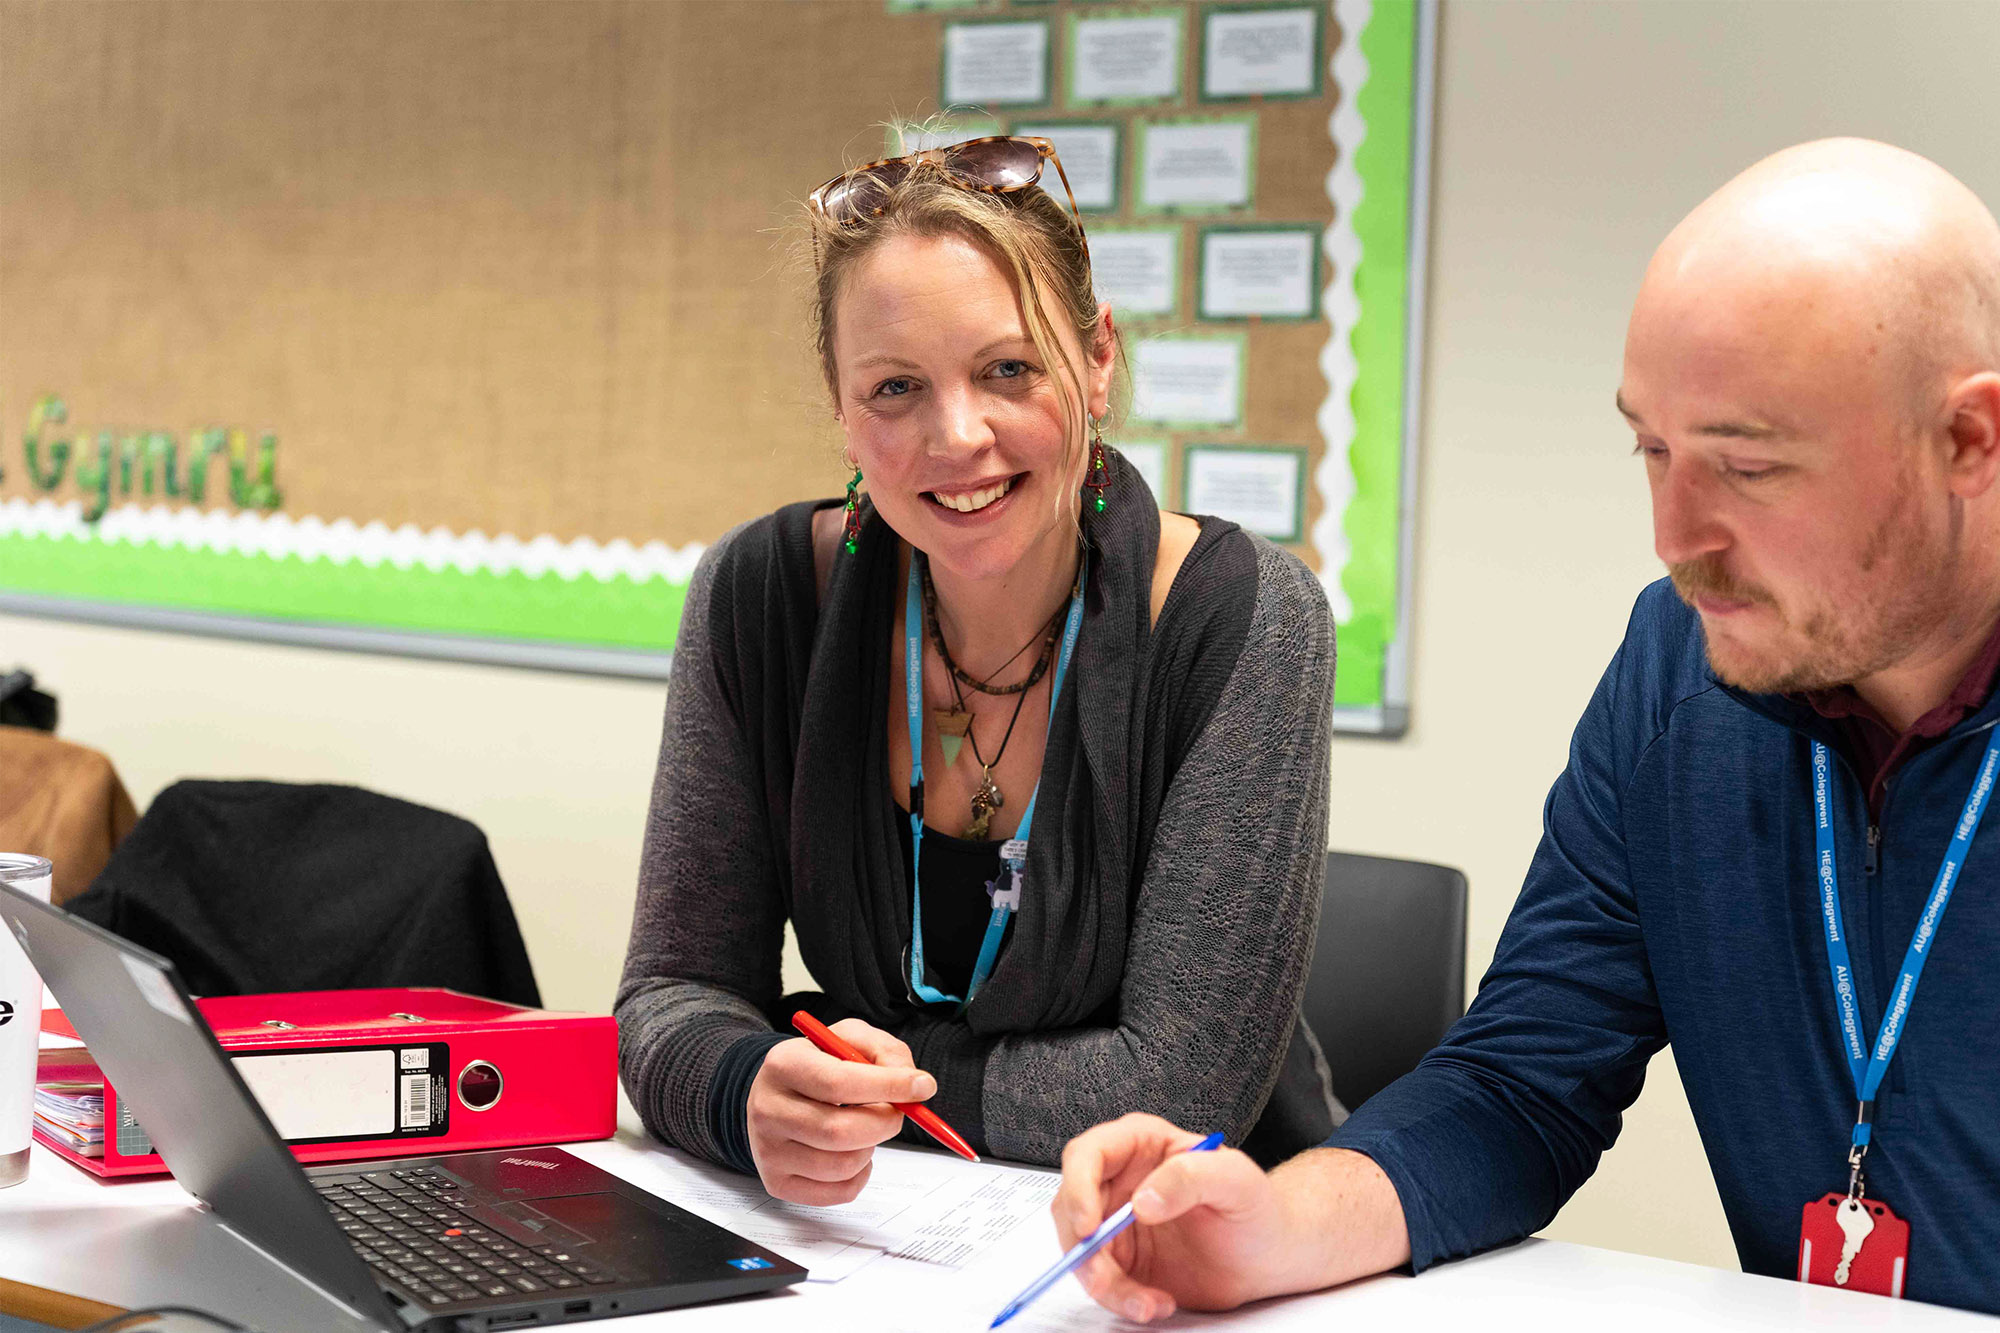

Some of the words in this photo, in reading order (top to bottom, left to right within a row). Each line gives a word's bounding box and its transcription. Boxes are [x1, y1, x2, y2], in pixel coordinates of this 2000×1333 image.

[24, 395, 283, 522] Gymru
[1814, 743, 1828, 829] U@Coleggwent
[1957, 748, 1999, 841] HE@Coleggwent
[1820, 849, 1840, 942] HE@Coleggwent
[1913, 861, 1956, 954] AU@Coleggwent
[1836, 965, 1863, 1060] AU@Coleggwent
[1876, 973, 1914, 1061] HE@Coleggwent
